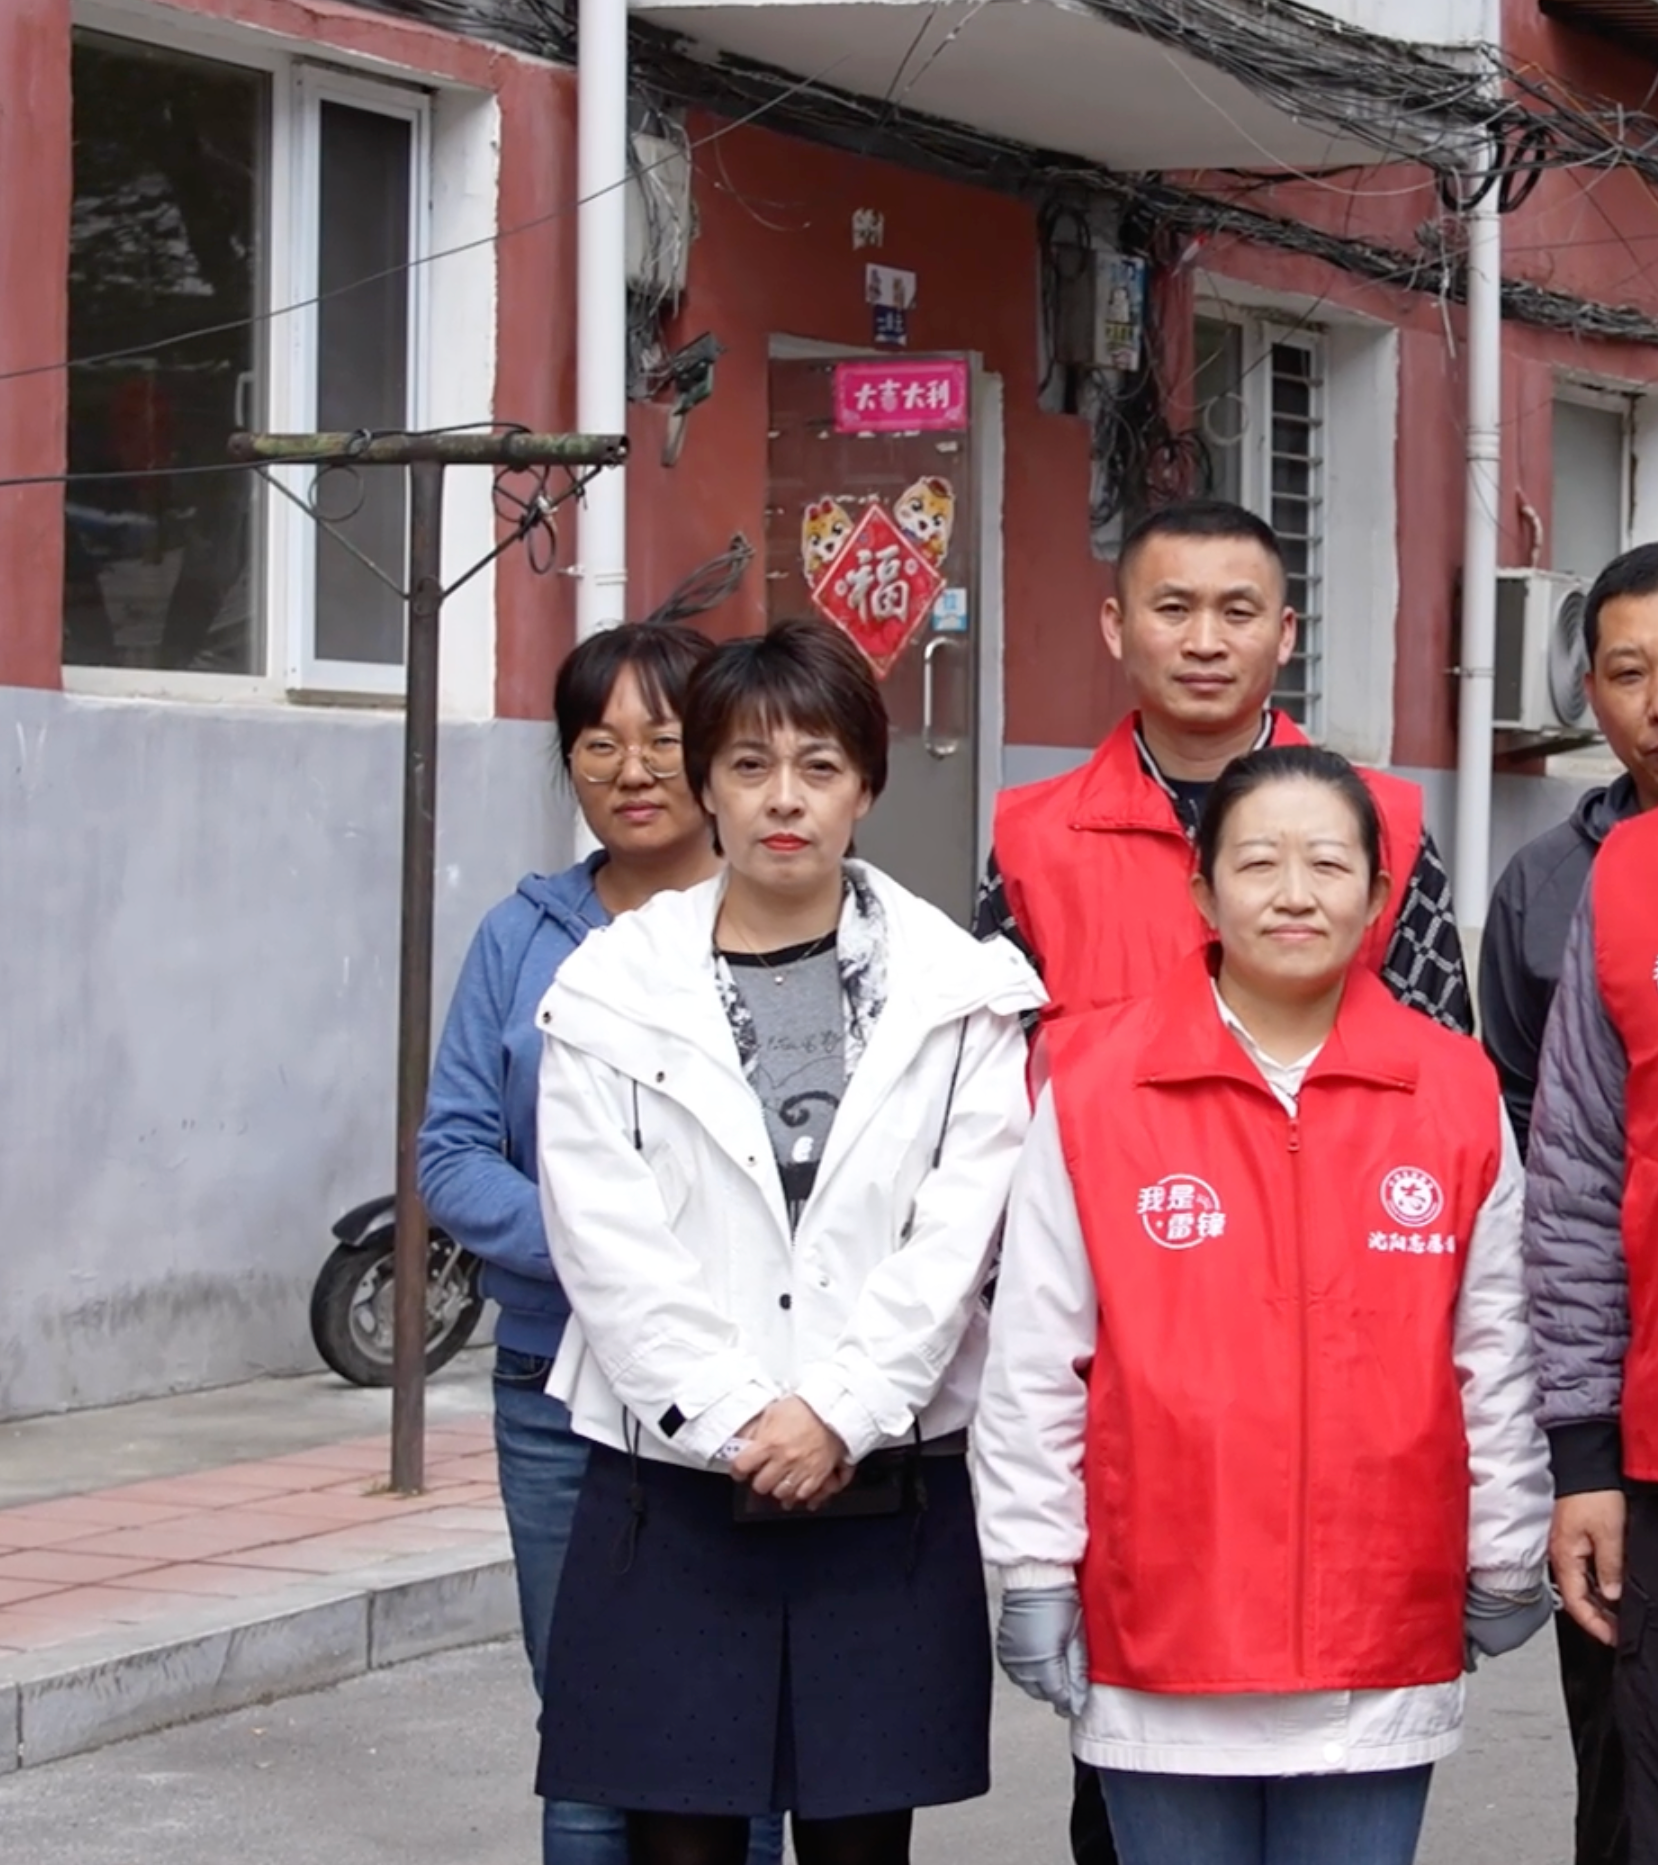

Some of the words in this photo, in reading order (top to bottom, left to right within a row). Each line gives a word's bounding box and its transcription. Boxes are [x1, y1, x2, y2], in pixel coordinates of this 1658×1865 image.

[854, 378, 950, 413] 大吉大利
[846, 544, 909, 624] 福
[1137, 1183, 1196, 1215] 我是
[1166, 1211, 1227, 1241] 雷锋
